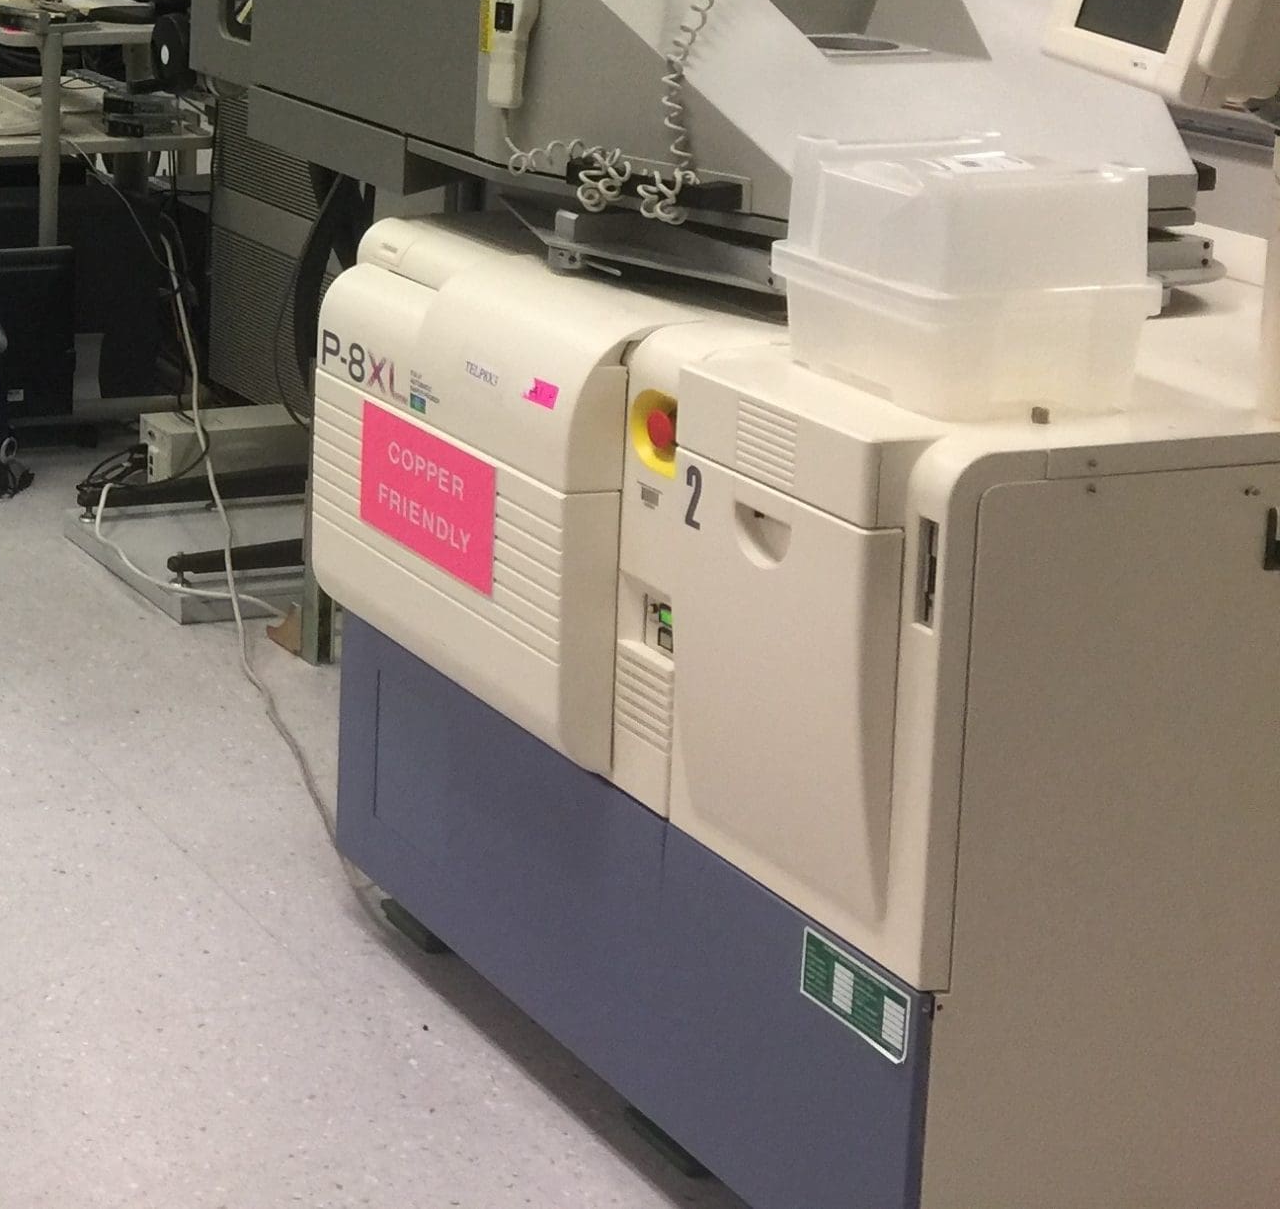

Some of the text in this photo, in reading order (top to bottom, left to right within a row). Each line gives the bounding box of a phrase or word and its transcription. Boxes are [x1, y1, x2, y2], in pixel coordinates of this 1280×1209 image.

[388, 441, 464, 501] COPPER
[685, 465, 702, 531] 2
[378, 483, 471, 553] FRIENDLY
